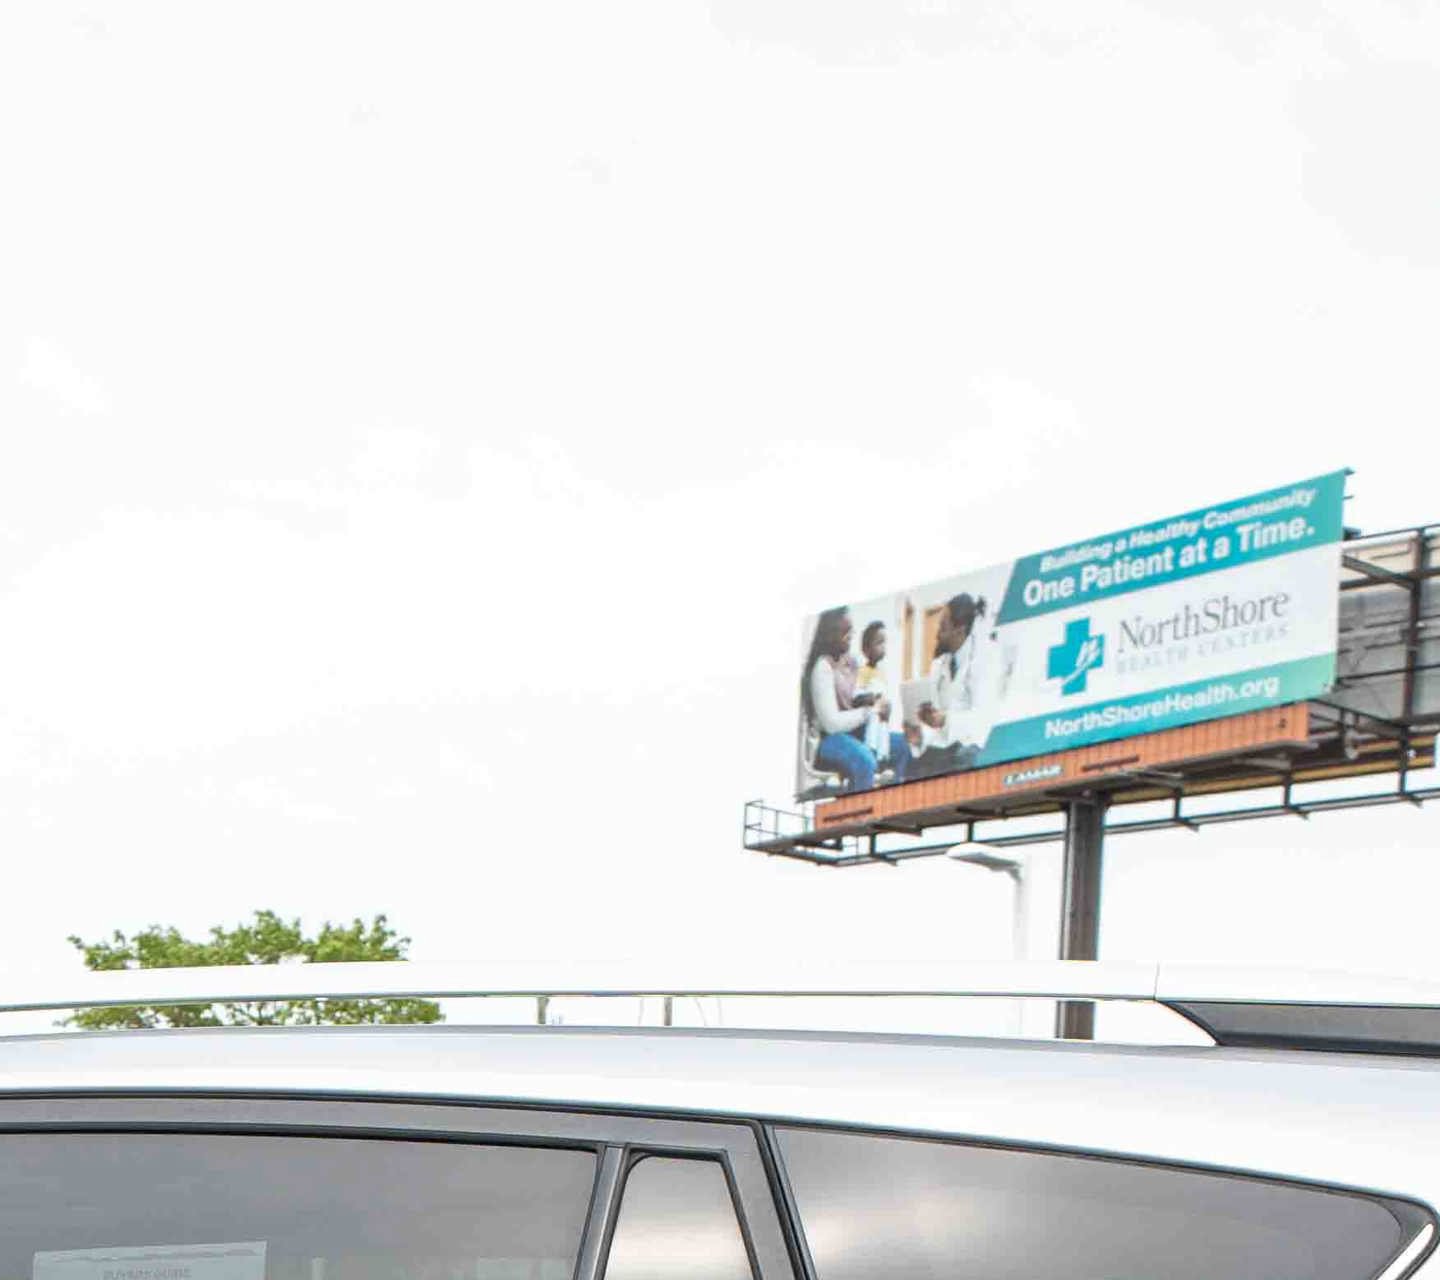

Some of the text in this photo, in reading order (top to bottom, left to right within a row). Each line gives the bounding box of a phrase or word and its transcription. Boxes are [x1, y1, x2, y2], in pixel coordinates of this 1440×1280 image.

[1023, 515, 1317, 607] One Patient at a Time.
[1039, 487, 1317, 573] Building a Healthy Community
[1118, 591, 1290, 653] NorthShore
[1044, 675, 1281, 739] NorthShoreHealth.org
